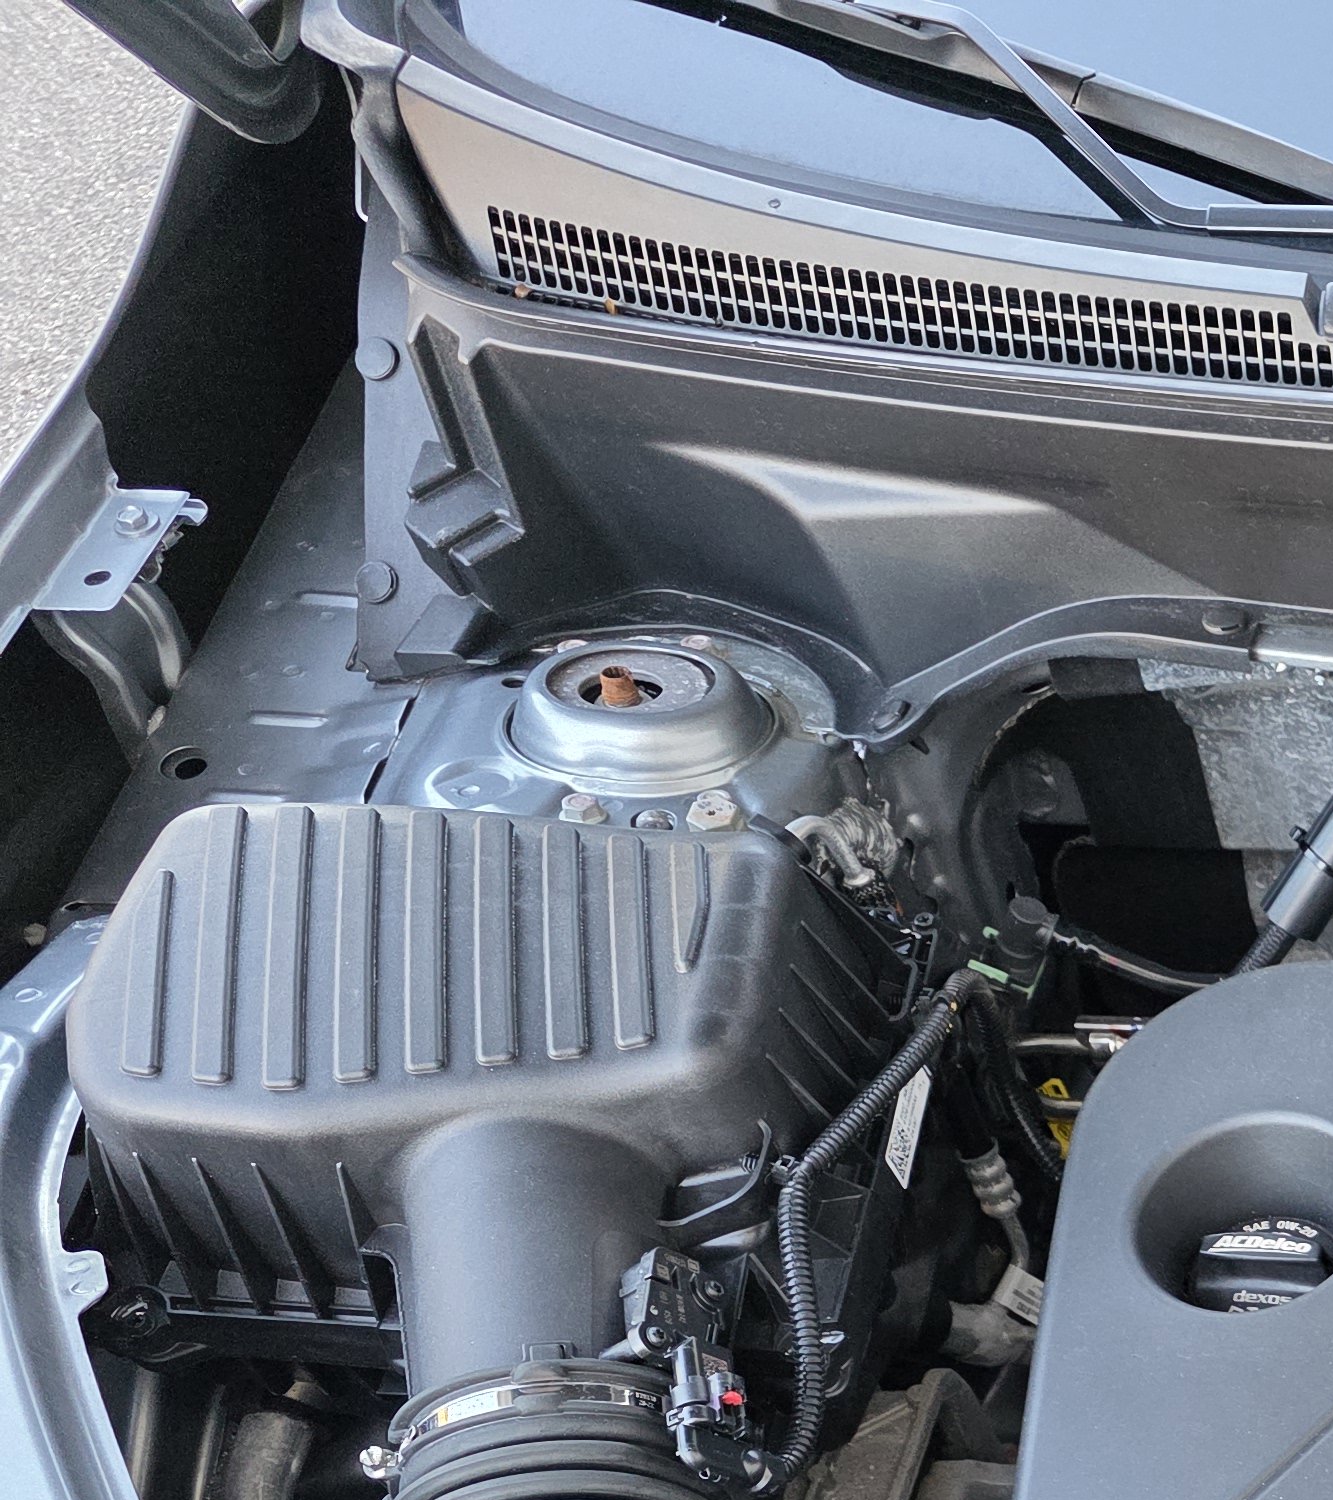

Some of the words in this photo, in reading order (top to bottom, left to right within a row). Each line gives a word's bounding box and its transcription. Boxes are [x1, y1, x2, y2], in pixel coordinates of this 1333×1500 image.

[1242, 1220, 1271, 1233] SAE
[1276, 1220, 1319, 1238] 0W-20
[1212, 1235, 1313, 1254] ACDelco
